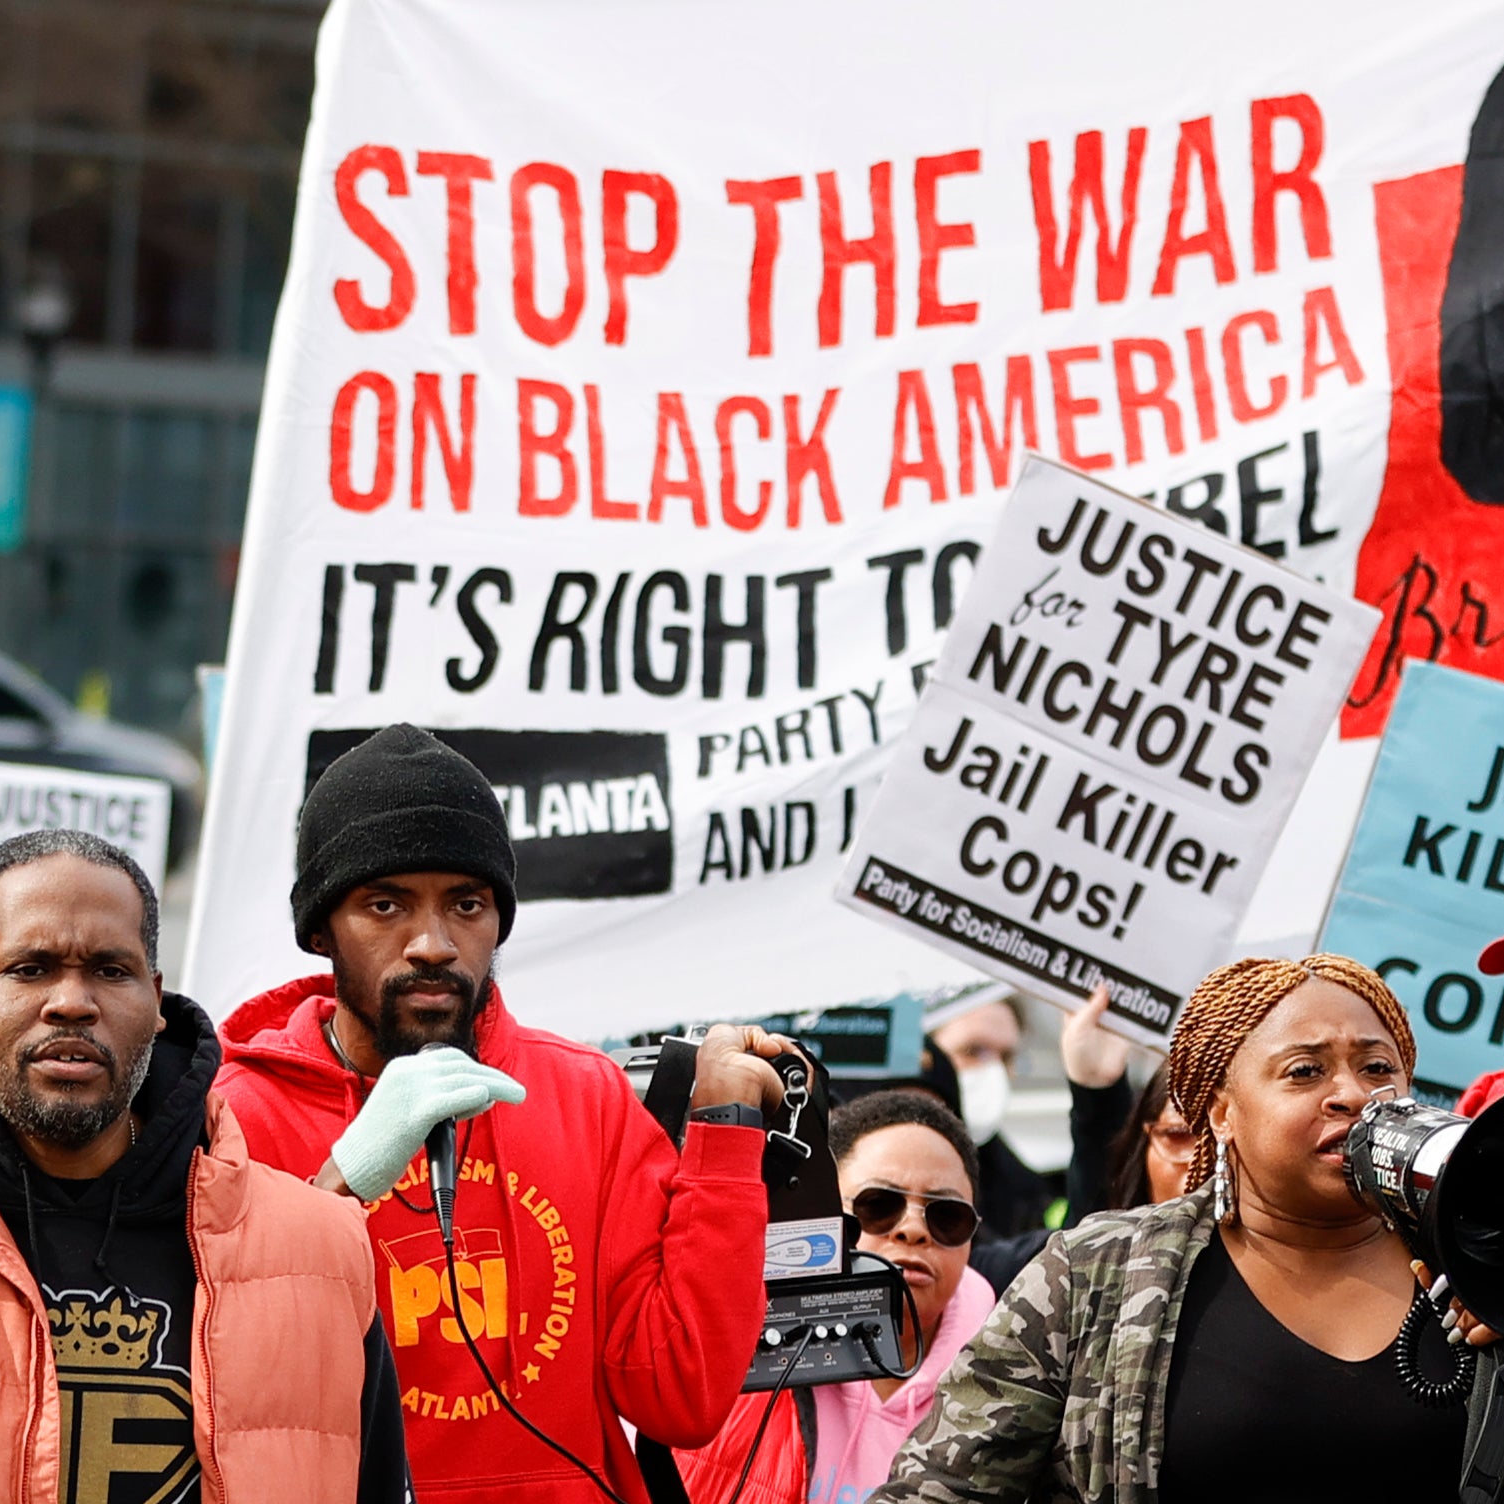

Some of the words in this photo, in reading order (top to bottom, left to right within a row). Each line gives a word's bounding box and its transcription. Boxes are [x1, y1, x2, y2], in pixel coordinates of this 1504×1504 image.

[333, 143, 681, 348] STOP
[724, 148, 982, 359] THE
[1027, 92, 1334, 315] WAR
[329, 370, 478, 514] ON
[516, 377, 845, 533] BLACK
[882, 285, 1367, 511] AMERICA
[313, 563, 515, 694] IT'S
[527, 565, 834, 700] RIGHT
[1133, 429, 1341, 559] BEL
[1009, 566, 1086, 628] for
[1106, 599, 1284, 734] TYRE
[1036, 496, 1334, 673] JUSTICE
[697, 679, 885, 779] PARTY
[967, 621, 1271, 806] NICHOLS
[492, 771, 671, 841] LANTA
[699, 800, 816, 885] AND
[922, 717, 1051, 815] Jail
[1056, 769, 1240, 896] Killer
[958, 814, 1146, 942] Cops!
[860, 865, 916, 918] Party
[917, 890, 950, 928] for
[951, 905, 1052, 972] Socialism
[1050, 947, 1071, 979] &
[519, 1186, 577, 1361] LIBERATION
